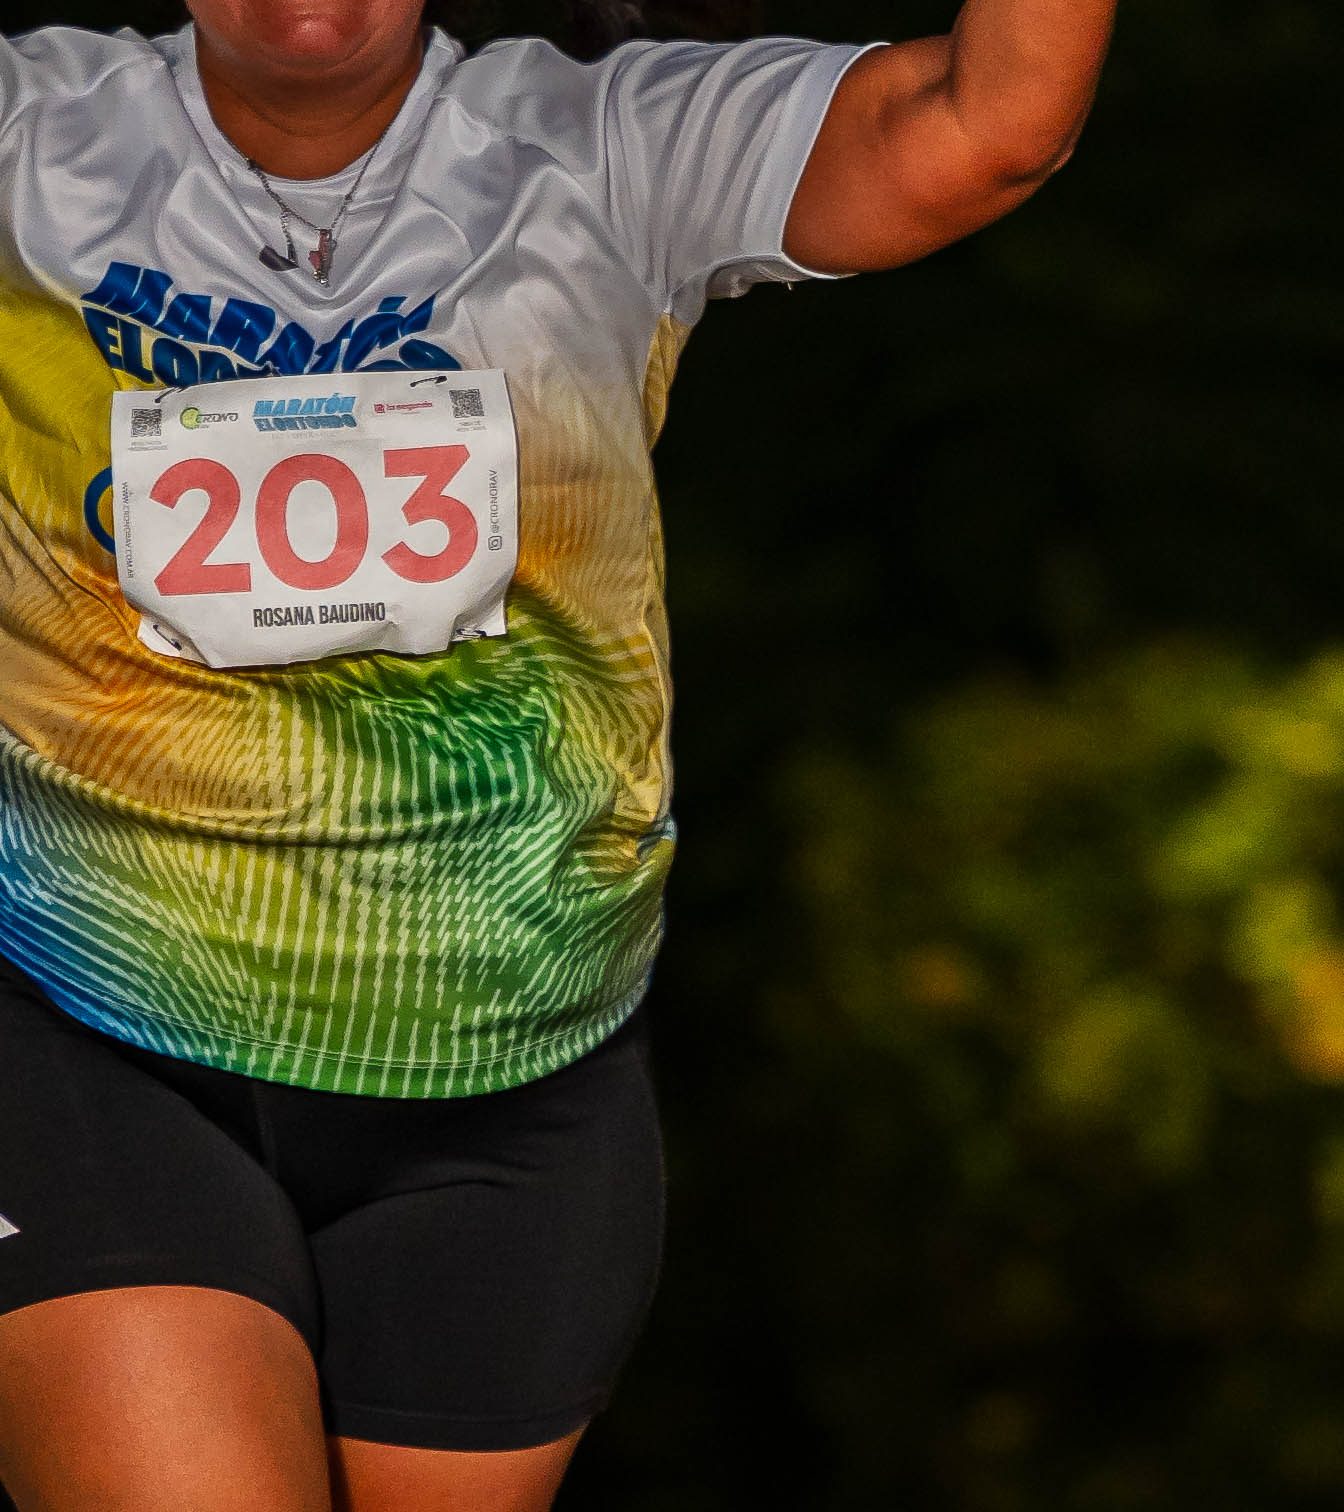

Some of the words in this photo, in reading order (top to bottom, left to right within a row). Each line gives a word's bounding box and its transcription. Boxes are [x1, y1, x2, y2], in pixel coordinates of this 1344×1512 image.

[253, 392, 356, 416] MARATÓN
[149, 443, 478, 596] 203
[253, 606, 315, 627] ROSANA
[318, 602, 386, 625] BAUDINO
